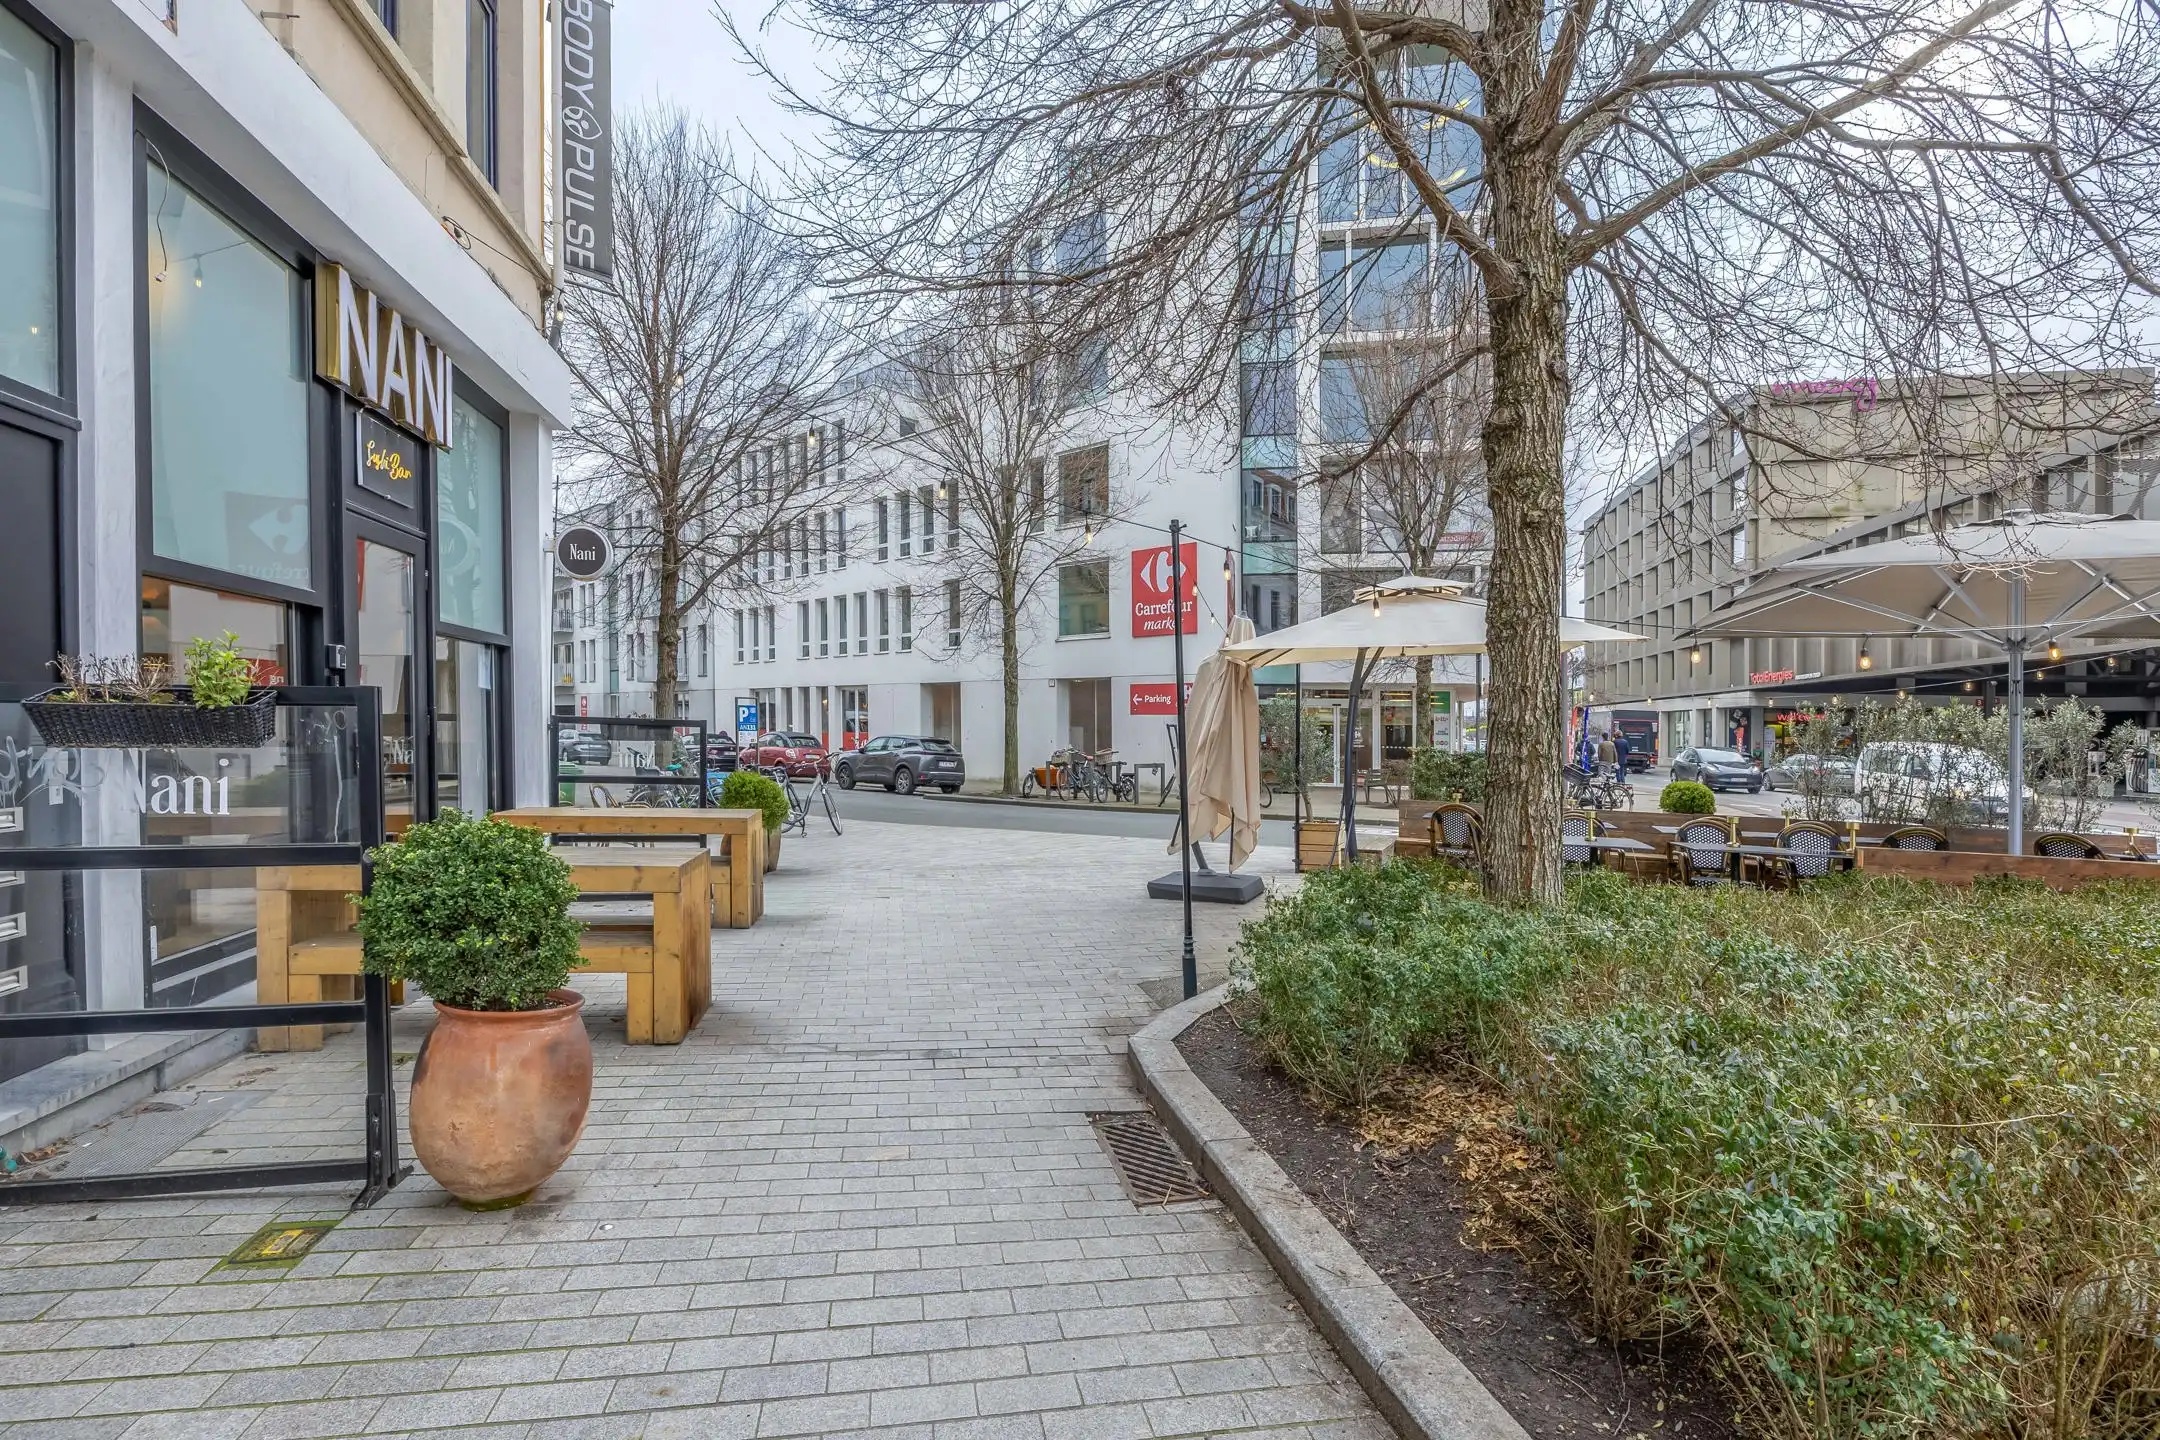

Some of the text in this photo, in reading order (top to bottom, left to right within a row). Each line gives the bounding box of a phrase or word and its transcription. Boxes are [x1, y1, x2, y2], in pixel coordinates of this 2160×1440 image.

[563, 0, 596, 271] BODY PULSE
[338, 264, 453, 449] NANI
[390, 453, 412, 480] Bar
[569, 543, 596, 561] Nani
[1751, 667, 1793, 684] TotalEnergies
[1144, 694, 1172, 705] Parking
[739, 706, 749, 723] P
[124, 747, 231, 815] Nani
